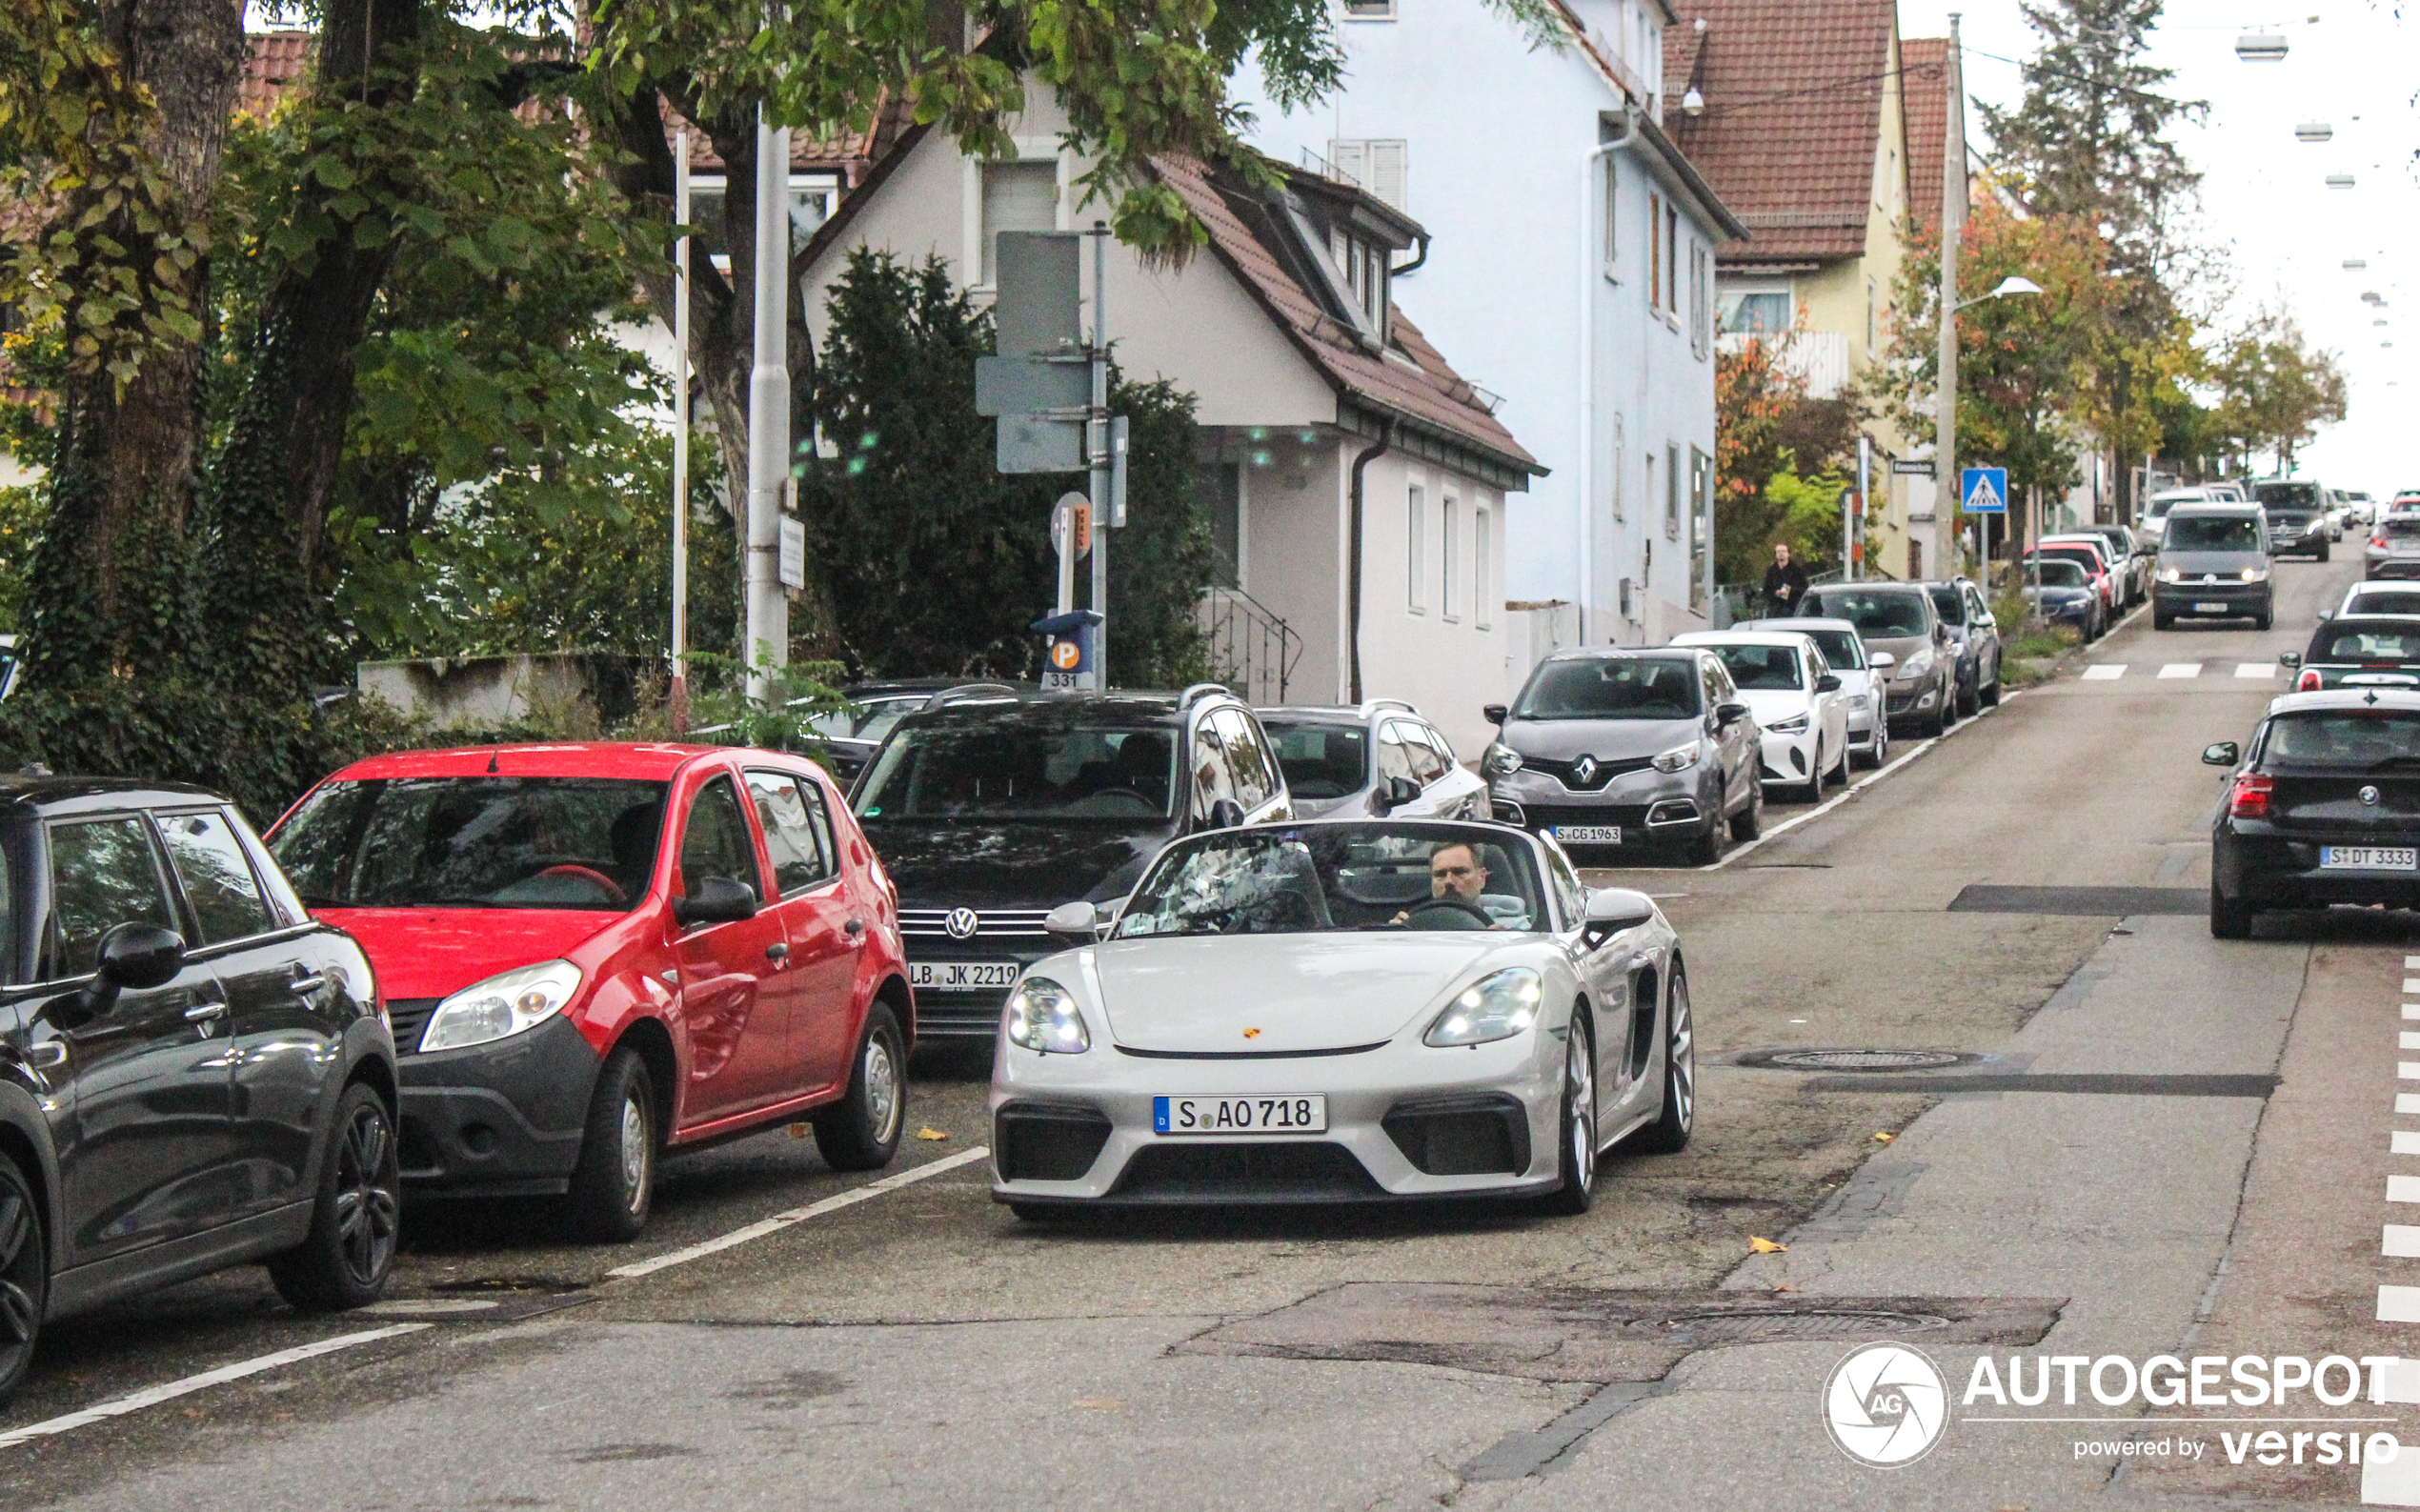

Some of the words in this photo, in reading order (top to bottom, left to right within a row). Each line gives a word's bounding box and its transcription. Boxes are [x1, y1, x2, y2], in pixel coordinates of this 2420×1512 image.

[1059, 643, 1076, 667] P
[1051, 674, 1078, 688] 331
[1557, 828, 1565, 840] S
[1572, 828, 1588, 840] CG
[1590, 828, 1620, 840] 1963
[2331, 849, 2341, 864] S
[2352, 849, 2372, 864] DT
[2375, 850, 2414, 865] 3333
[910, 965, 933, 984] LB
[946, 965, 968, 985] JK
[973, 965, 1018, 985] 2219
[1180, 1100, 1197, 1128] S
[1259, 1099, 1312, 1127] 718
